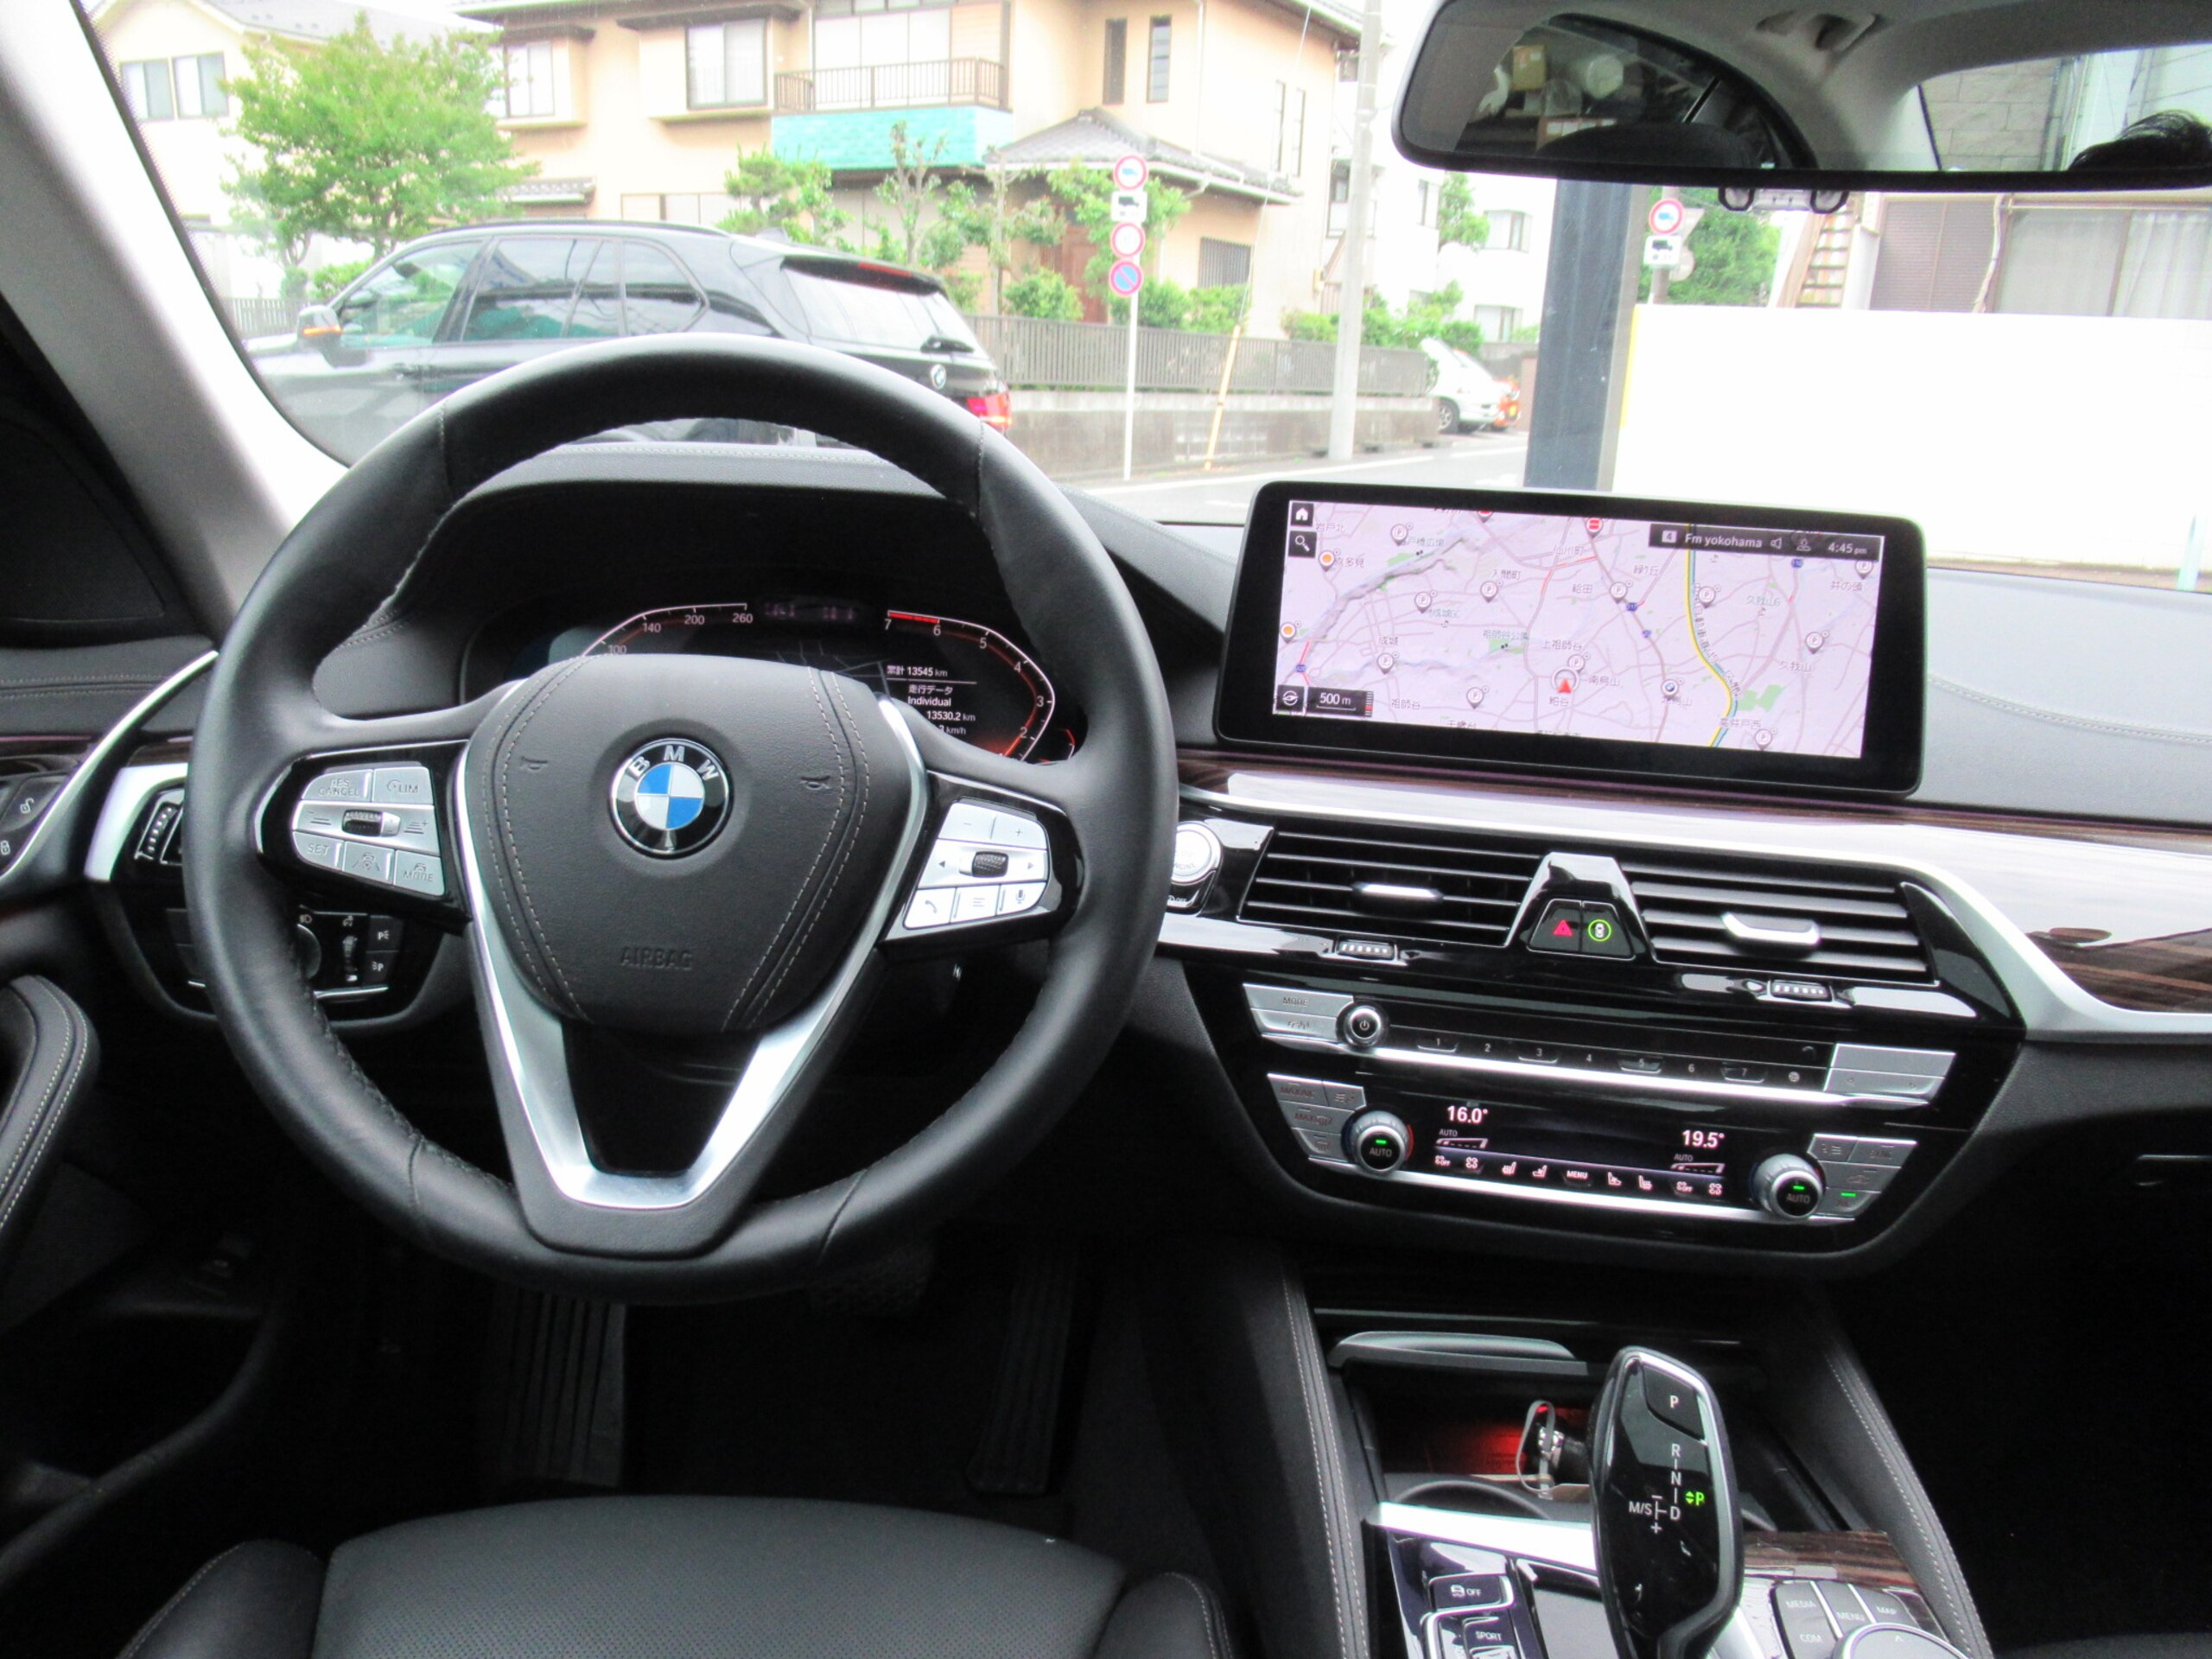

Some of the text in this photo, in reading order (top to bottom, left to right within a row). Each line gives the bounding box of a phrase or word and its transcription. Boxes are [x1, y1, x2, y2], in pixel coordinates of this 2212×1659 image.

[1684, 533, 1702, 544] Fm
[1704, 534, 1763, 549] yokohama
[1827, 543, 1853, 554] 4:45
[683, 614, 705, 626] 200
[732, 613, 753, 624] 260
[884, 618, 892, 631] 7
[642, 622, 662, 633] 140
[933, 624, 942, 637] 6
[978, 637, 988, 650] 5
[607, 645, 627, 655] 100
[886, 664, 949, 677] 累計 13545 km
[1014, 660, 1022, 673] 4
[908, 683, 954, 696] 走行データ
[907, 696, 952, 707] Individual
[1036, 695, 1045, 708] 3
[1319, 691, 1352, 705] 500 m
[926, 710, 976, 722] 13530.2 km
[945, 726, 967, 735] km/h
[1019, 726, 1028, 739] 2
[397, 782, 419, 794] LIM
[307, 842, 330, 856] SET
[403, 869, 435, 883] MODE
[620, 946, 692, 970] AIRBAG
[1435, 1038, 1441, 1046] 1
[1484, 1043, 1491, 1053] 2
[1535, 1047, 1543, 1058] 3
[1586, 1053, 1592, 1063] 4
[1688, 1063, 1695, 1073] 6
[1741, 1067, 1749, 1077] 7
[1439, 1128, 1459, 1138] AUTO
[1369, 1146, 1393, 1159] AUTO
[1673, 1153, 1694, 1163] AUTO
[1566, 1169, 1589, 1180] MENU
[1786, 1192, 1811, 1205] AUTO
[1669, 1395, 1680, 1409] P
[1671, 1443, 1681, 1458] R
[1670, 1471, 1681, 1486] N
[1694, 1491, 1706, 1506] P
[1628, 1500, 1653, 1516] M/S
[1669, 1506, 1681, 1521] D
[1465, 1587, 1482, 1597] OFF
[1784, 1599, 1817, 1609] MEDIA
[1876, 1605, 1897, 1616] MAP
[1474, 1630, 1503, 1642] SPORT
[1799, 1633, 1822, 1643] COM
